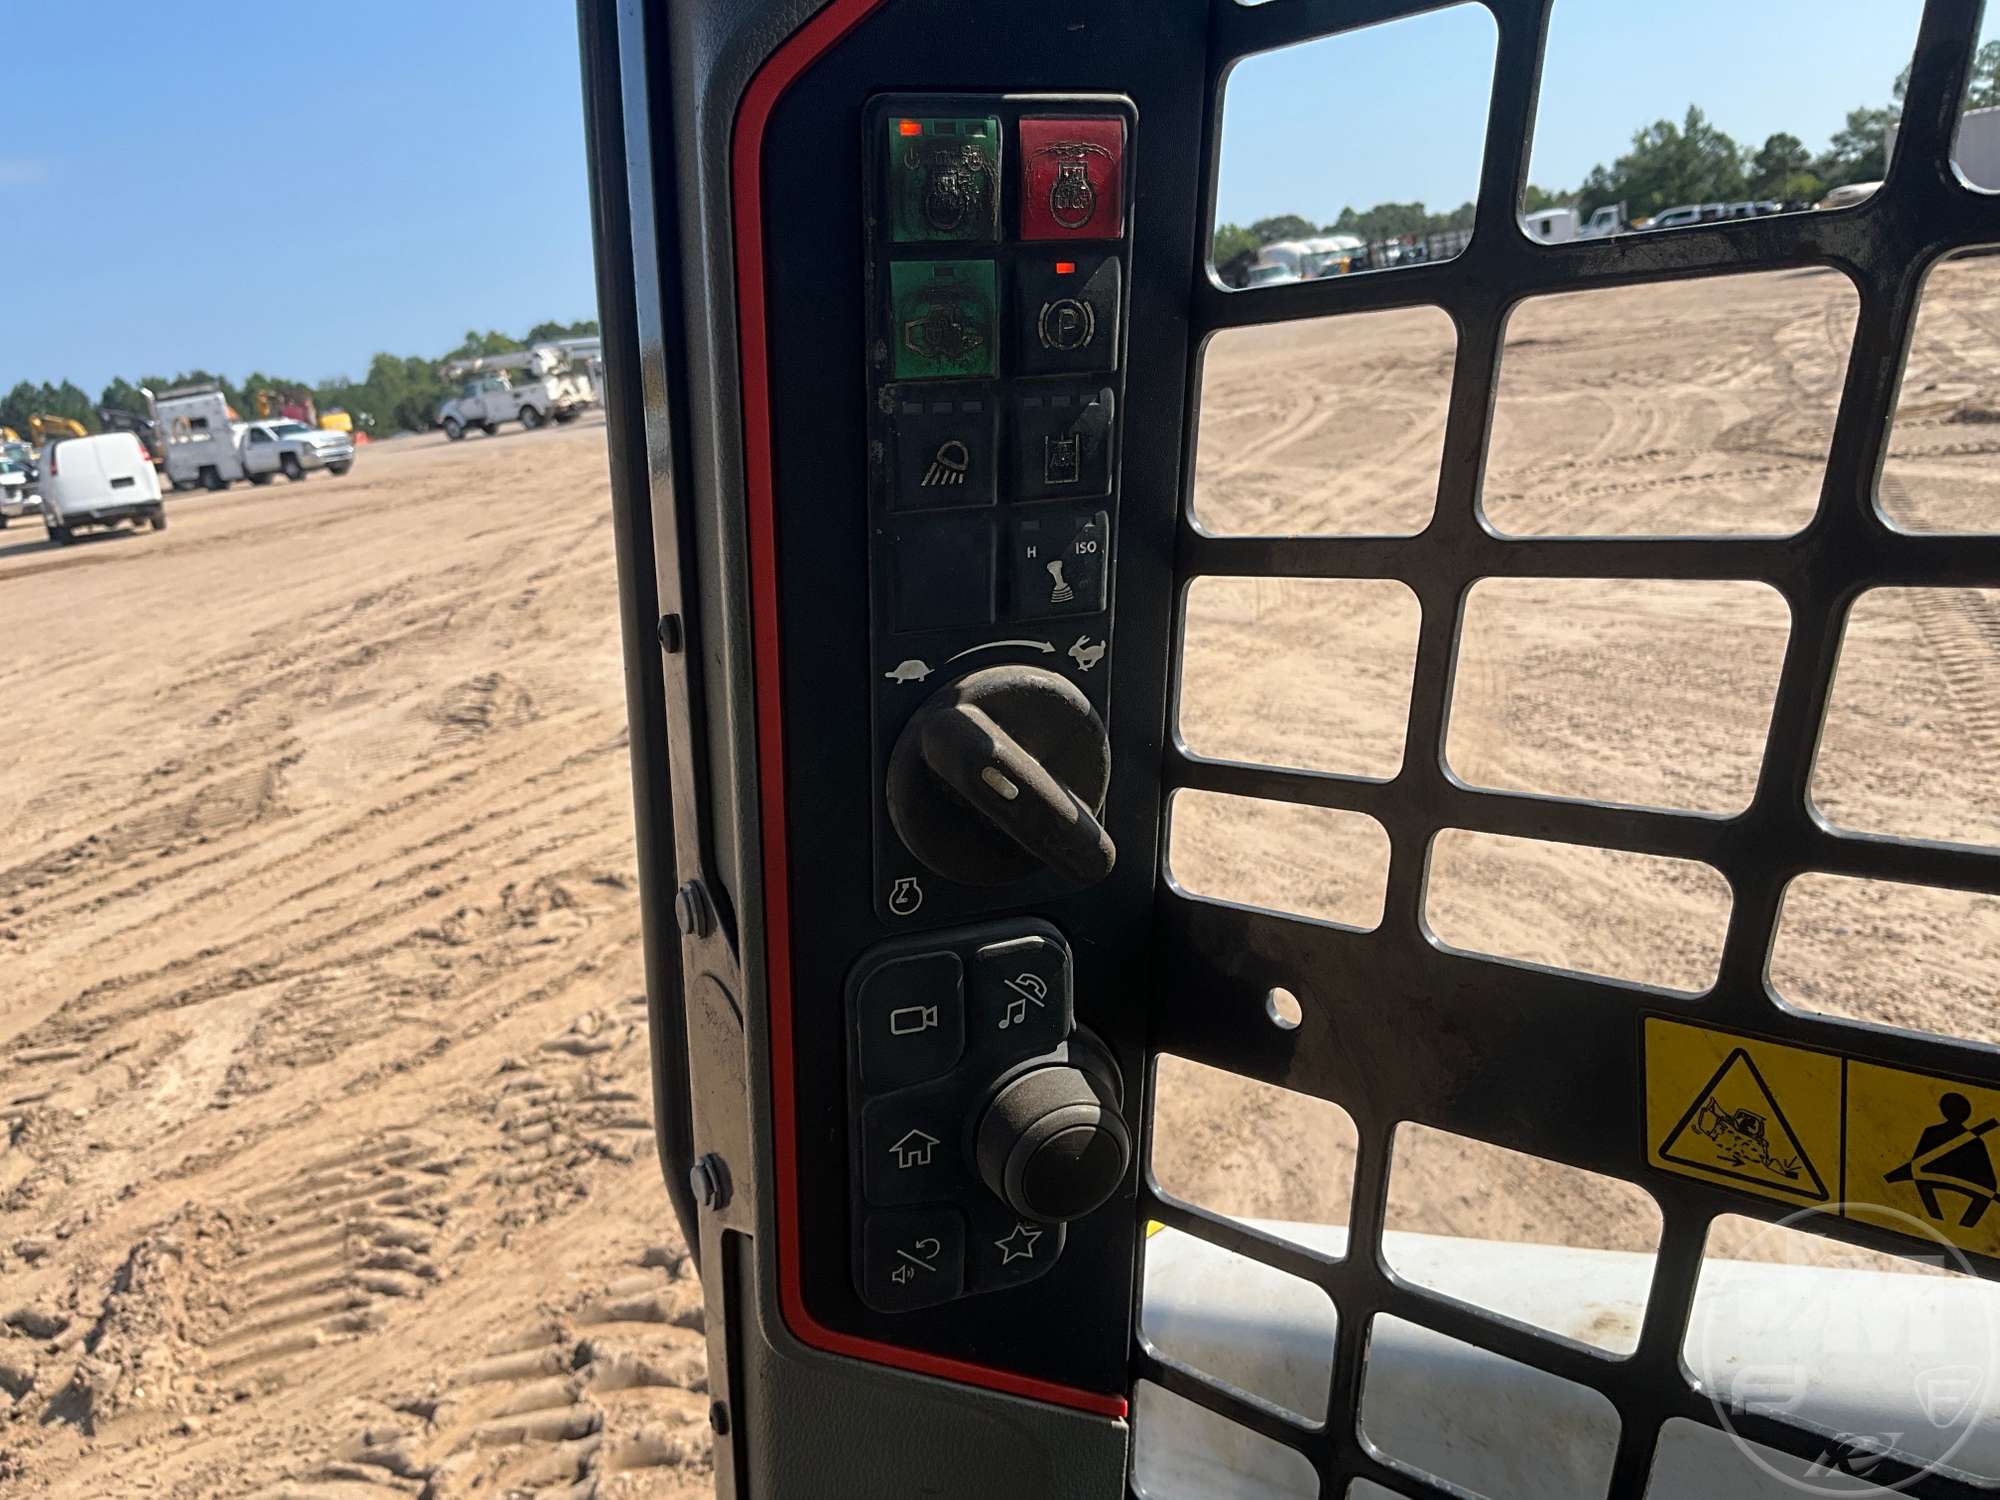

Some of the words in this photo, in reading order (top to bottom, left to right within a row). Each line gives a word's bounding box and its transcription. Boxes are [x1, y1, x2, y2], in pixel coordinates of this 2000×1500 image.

[1058, 308, 1078, 344] P
[1026, 545, 1037, 559] H
[1074, 540, 1097, 555] ISO
